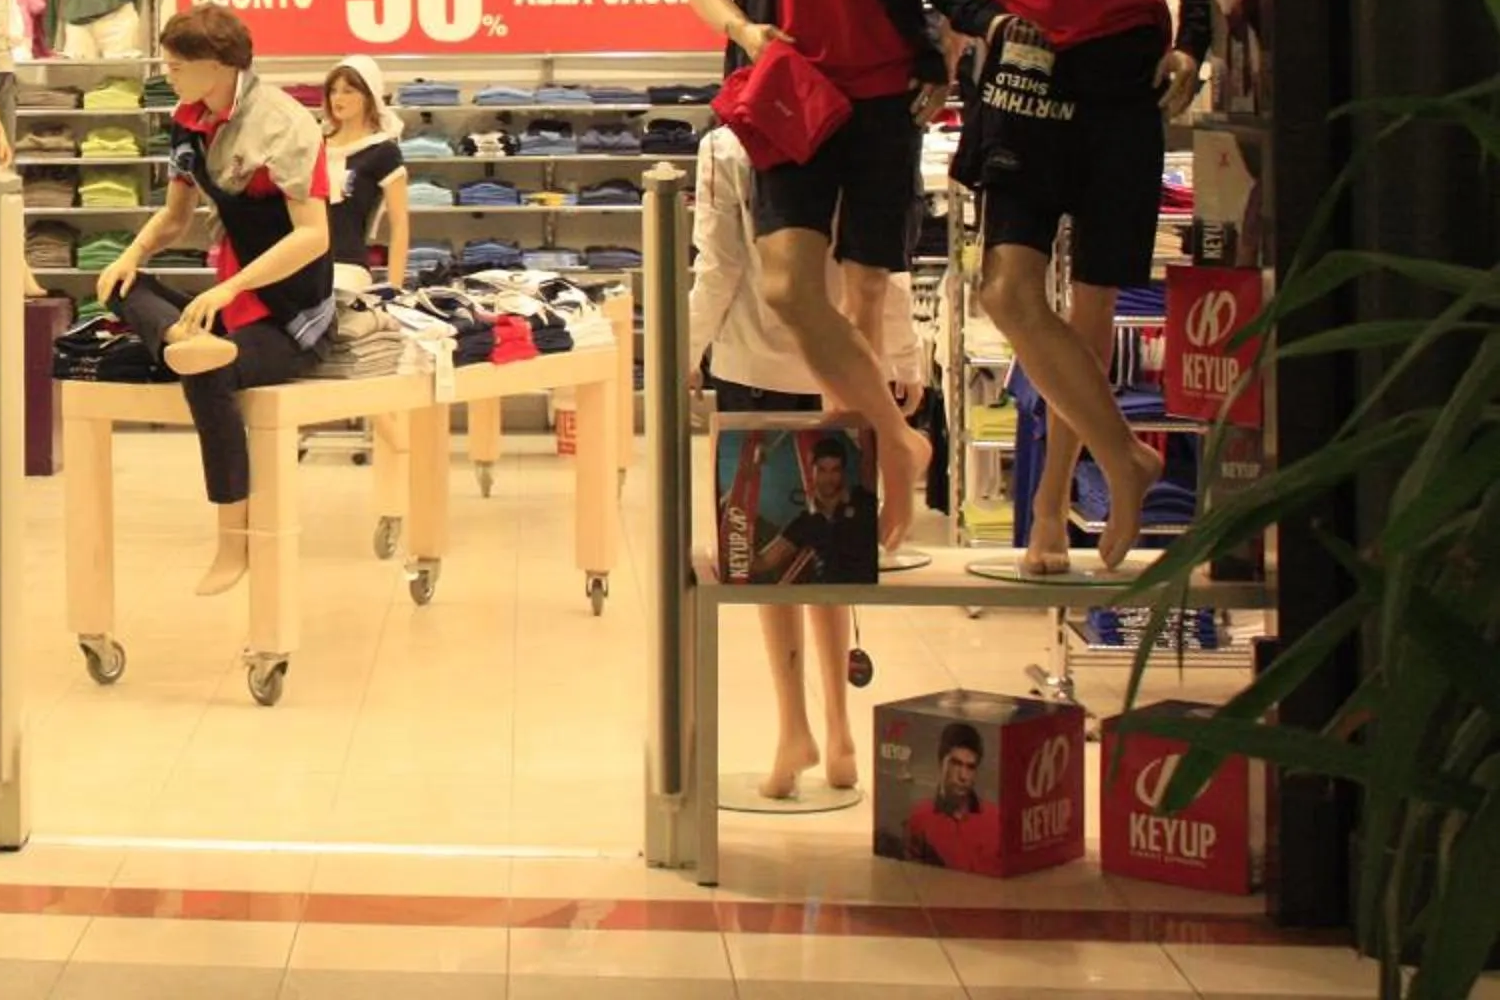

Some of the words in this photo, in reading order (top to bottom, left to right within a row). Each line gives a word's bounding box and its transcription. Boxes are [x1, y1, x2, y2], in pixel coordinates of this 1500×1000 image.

[1182, 353, 1239, 393] KEYUP
[1022, 799, 1072, 844] KEYUP
[1129, 811, 1216, 860] KEYUP
